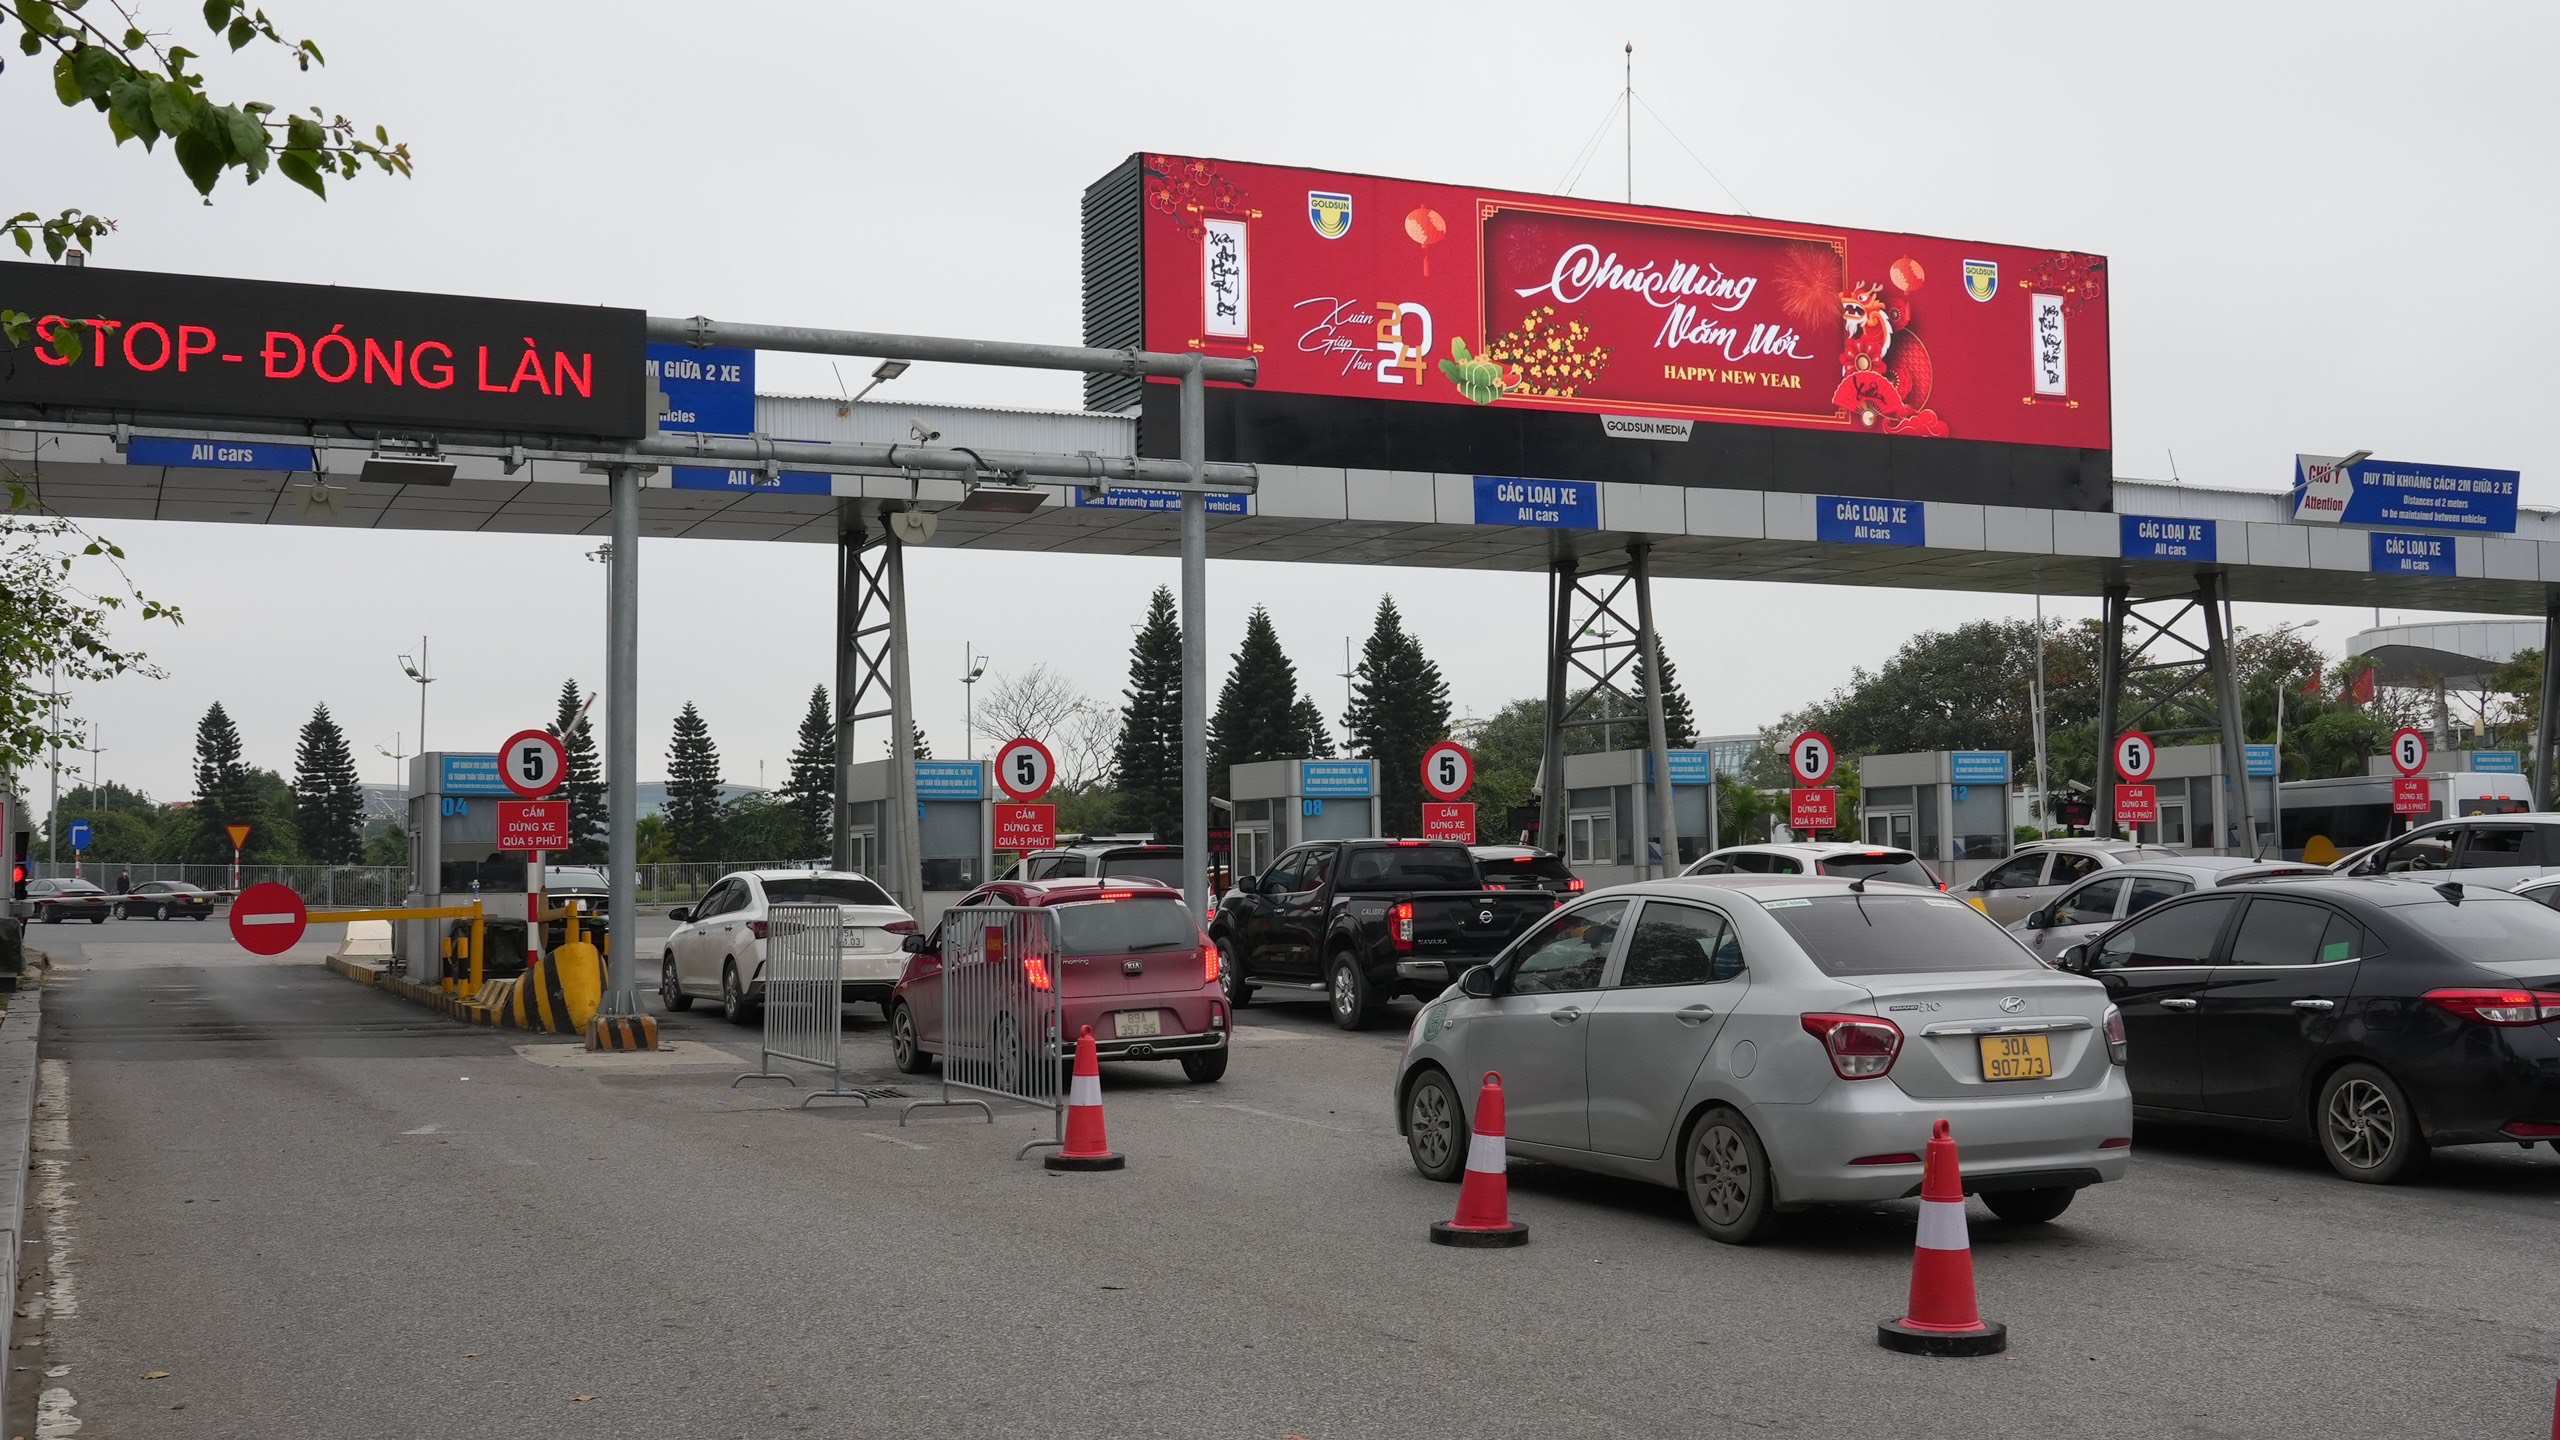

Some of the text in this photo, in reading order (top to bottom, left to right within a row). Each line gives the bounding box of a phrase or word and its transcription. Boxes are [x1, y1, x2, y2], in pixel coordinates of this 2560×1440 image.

[1311, 199, 1349, 210] GOLDSUN
[1514, 244, 1757, 311] Chúc Mừng
[1966, 267, 1995, 276] GOLDSUN
[1293, 297, 1374, 326] Xuân
[1654, 302, 1814, 361] Năm Mới
[1298, 325, 1352, 355] Giáp
[260, 324, 455, 390] ĐÓNG
[478, 337, 592, 398] LÀN
[664, 358, 702, 380] GIỮA
[706, 365, 716, 382] 2
[720, 365, 741, 382] XE
[1664, 365, 1802, 389] HAPPY NEW YEAR
[1607, 421, 1688, 436] GOLDSUN MEDIA
[192, 444, 253, 463] All cars
[728, 469, 747, 485] All
[2309, 463, 2331, 484] CHÚ
[2363, 471, 2513, 495] DUY TRÌ KHOẢNG CÁCH 2M GIỮA 2 XE
[1497, 481, 1577, 507] CÁC LOẠI XE
[2403, 495, 2469, 509] Distances of 2 meters
[1107, 496, 1118, 506] for
[1119, 497, 1147, 508] priority
[1149, 498, 1164, 507] and
[1208, 501, 1241, 512] vehicles
[2304, 495, 2343, 511] Attention
[1518, 507, 1560, 522] All cars
[1836, 501, 1907, 525] CÁC LOẠI XE
[2381, 508, 2487, 524] to be maintained between vehicles
[1854, 525, 1891, 540] All cars
[2139, 520, 2202, 542] CÁC LOẠI XE
[2154, 543, 2187, 556] All cars
[2386, 537, 2441, 557] CÁC LOẠI XE
[2401, 558, 2430, 571] All cars
[1805, 746, 1819, 773] 5
[2128, 744, 2141, 770] 5
[2403, 740, 2414, 764] 5
[523, 747, 544, 781] 5
[1016, 754, 1035, 786] 5
[1439, 756, 1456, 786] 5
[1805, 793, 1821, 803] CẤM
[1952, 785, 1968, 801] 12
[2129, 788, 2143, 798] CẤM
[441, 797, 469, 817] 04
[522, 805, 545, 818] CẤM
[1303, 799, 1323, 816] 08
[1441, 806, 1458, 818] CẤM
[1797, 804, 1827, 814] DỪNG XE
[2121, 799, 2149, 809] DỪNG XE
[1015, 808, 1036, 820] CẤM
[1794, 816, 1809, 826] QUÁ
[1815, 816, 1834, 825] PHÚT
[2118, 810, 2131, 820] QUÁ
[2137, 810, 2153, 820] PHÚT
[509, 820, 555, 832] DỪNG XE
[1003, 822, 1044, 833] DỪNG XE
[1430, 820, 1465, 830] DỪNG XE
[528, 836, 534, 846] 5
[536, 834, 563, 846] PHÚT
[998, 836, 1050, 847] QUÁ 5 PHÚT
[1452, 831, 1471, 842] PHÚT
[1126, 960, 1141, 969] KIA
[1128, 1013, 1147, 1024] 89A
[1121, 1024, 1156, 1036] 357.95
[2000, 1038, 2031, 1056] 30A
[1991, 1058, 2044, 1077] 907.73
